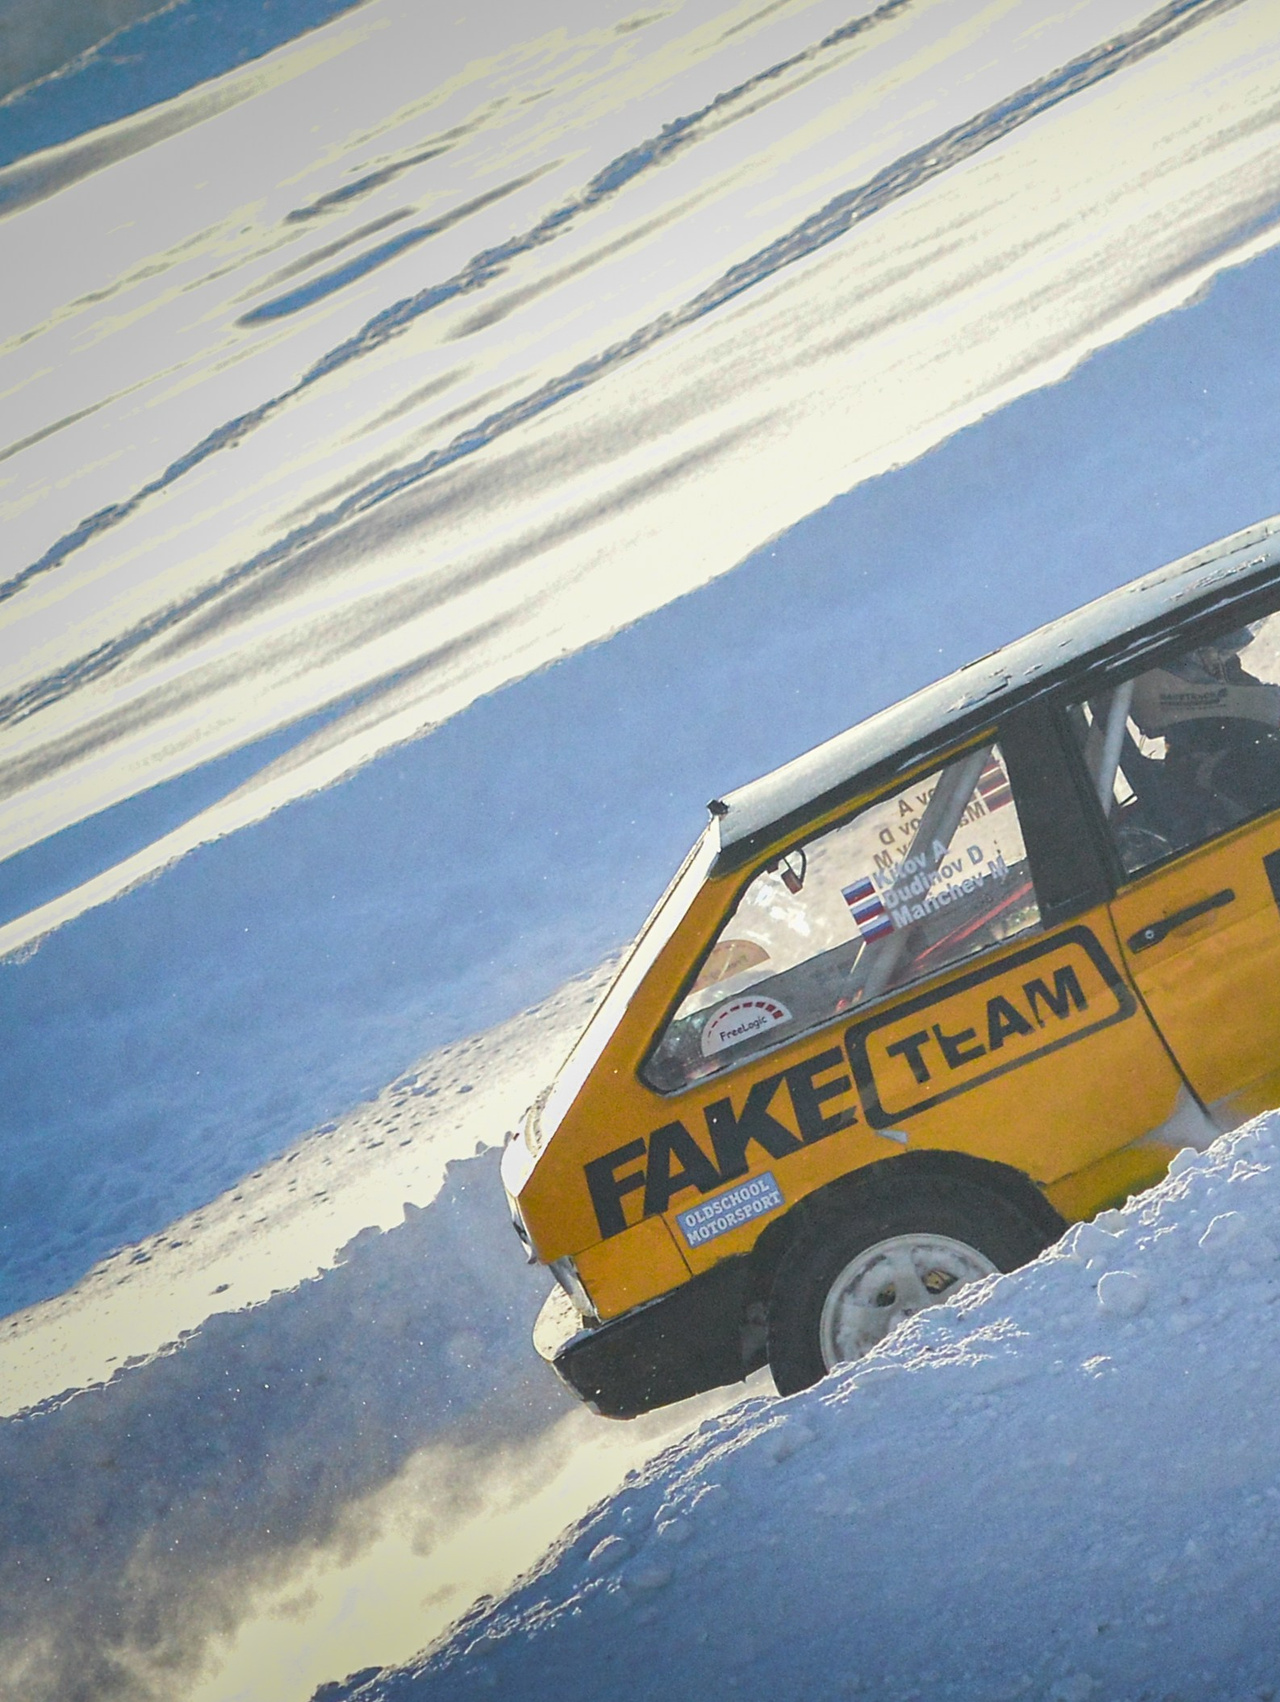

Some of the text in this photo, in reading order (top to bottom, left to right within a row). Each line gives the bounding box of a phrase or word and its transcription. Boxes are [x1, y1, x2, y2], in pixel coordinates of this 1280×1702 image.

[882, 844, 984, 910] Dudinov D
[931, 838, 949, 863] A
[890, 854, 1010, 928] Marichev M
[719, 1016, 767, 1041] FreeLogic
[583, 965, 1089, 1239] FAKE TEAM
[685, 1180, 770, 1227] OLDSCHOOL
[686, 1191, 781, 1246] MOTORSPORT
